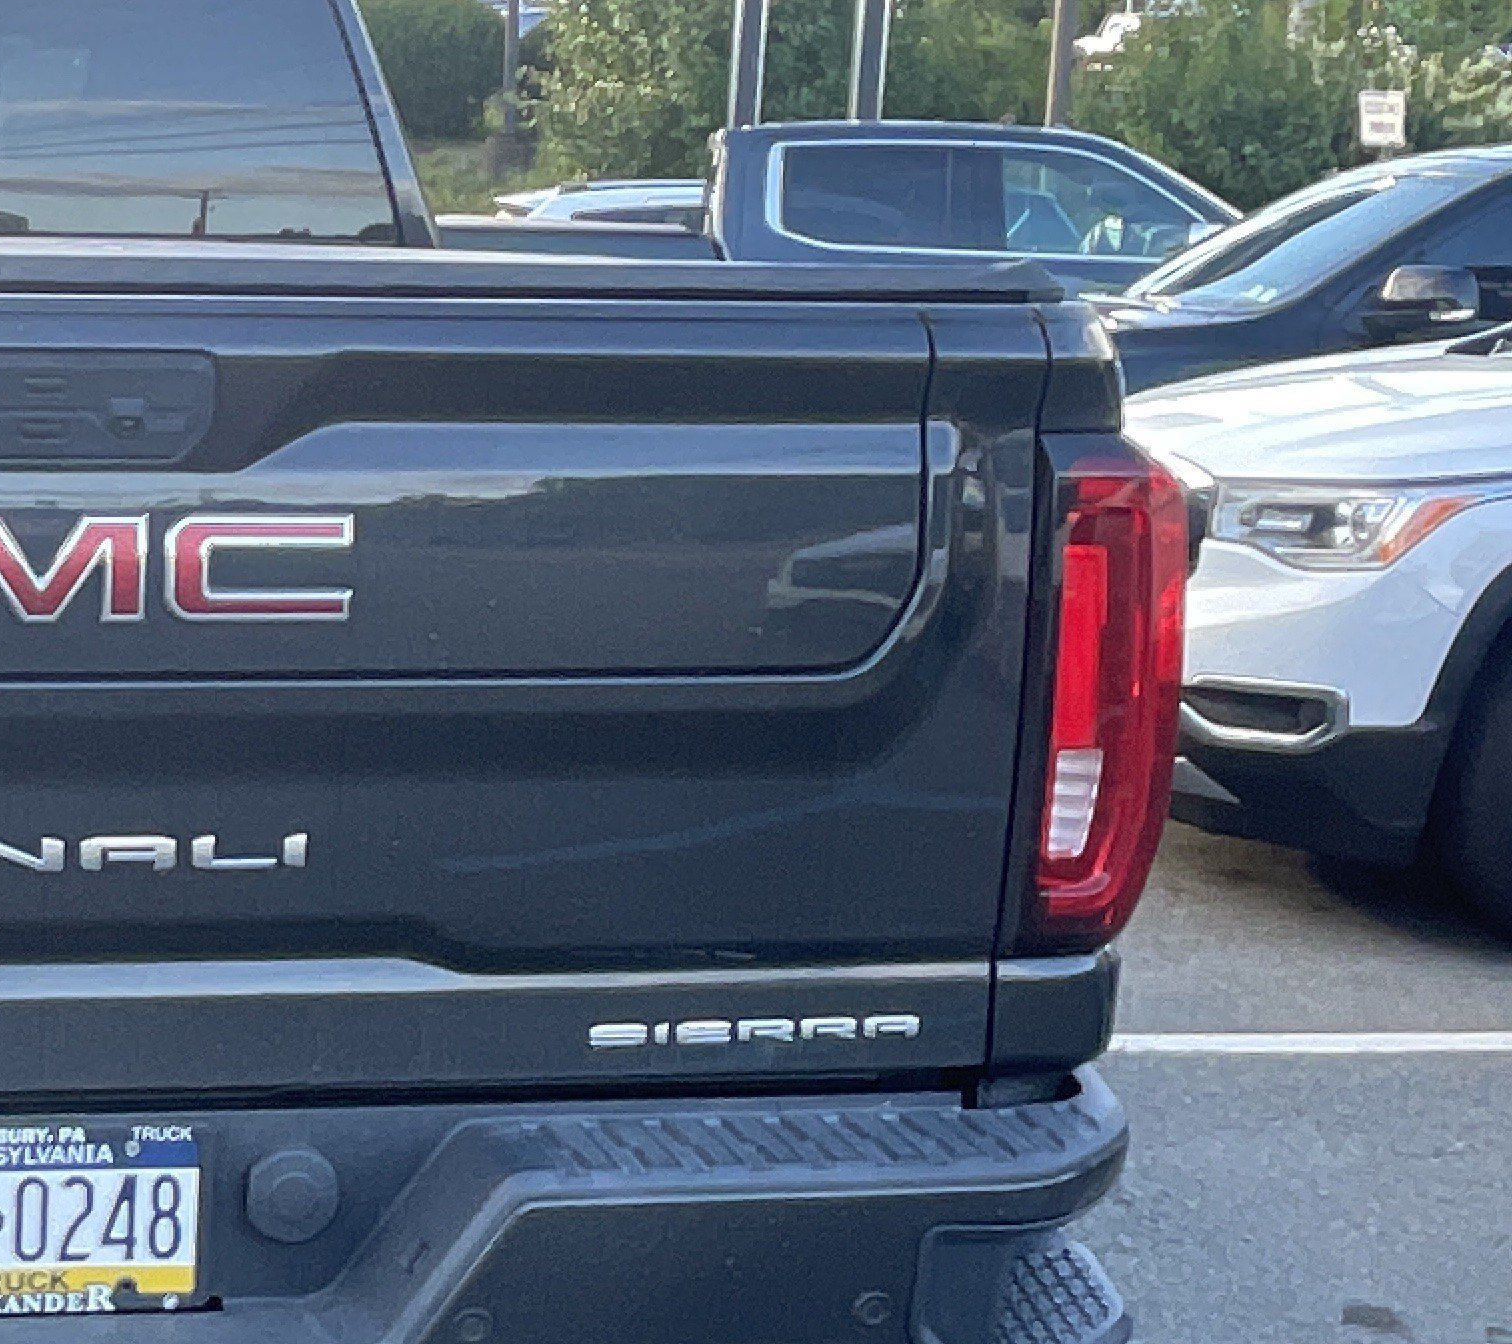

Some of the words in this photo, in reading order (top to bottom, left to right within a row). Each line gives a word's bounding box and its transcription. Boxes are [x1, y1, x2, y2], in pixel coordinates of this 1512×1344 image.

[588, 1014, 921, 1047] SIERRA
[58, 1126, 86, 1142] PA
[130, 1125, 192, 1142] TRUCK
